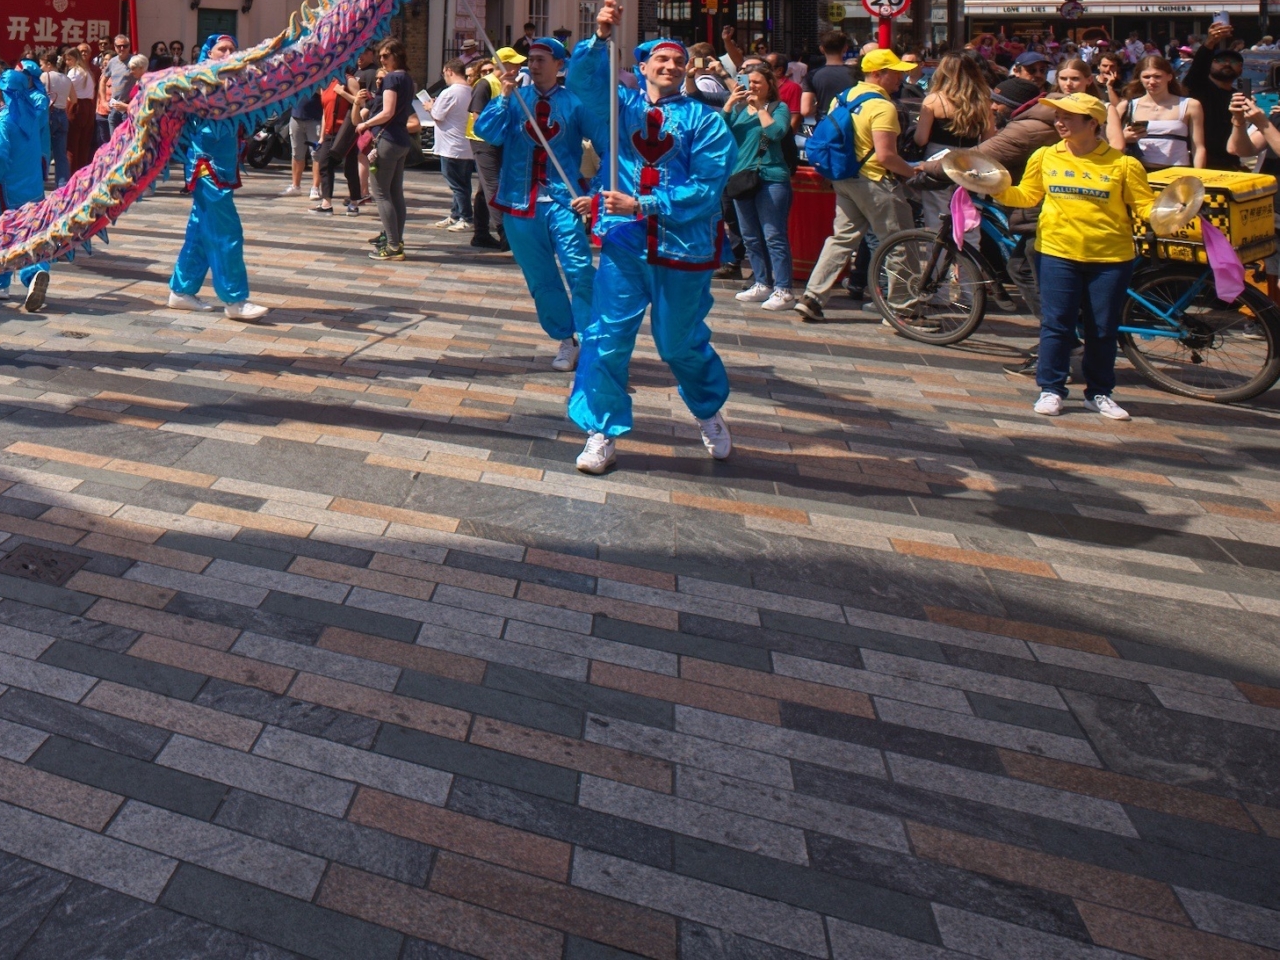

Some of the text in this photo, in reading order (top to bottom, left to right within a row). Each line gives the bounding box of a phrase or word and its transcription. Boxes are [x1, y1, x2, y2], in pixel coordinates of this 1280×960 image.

[7, 16, 110, 43] 开业在即
[1048, 169, 1111, 182] 法輪大法
[1050, 186, 1108, 198] FALUN DAFA
